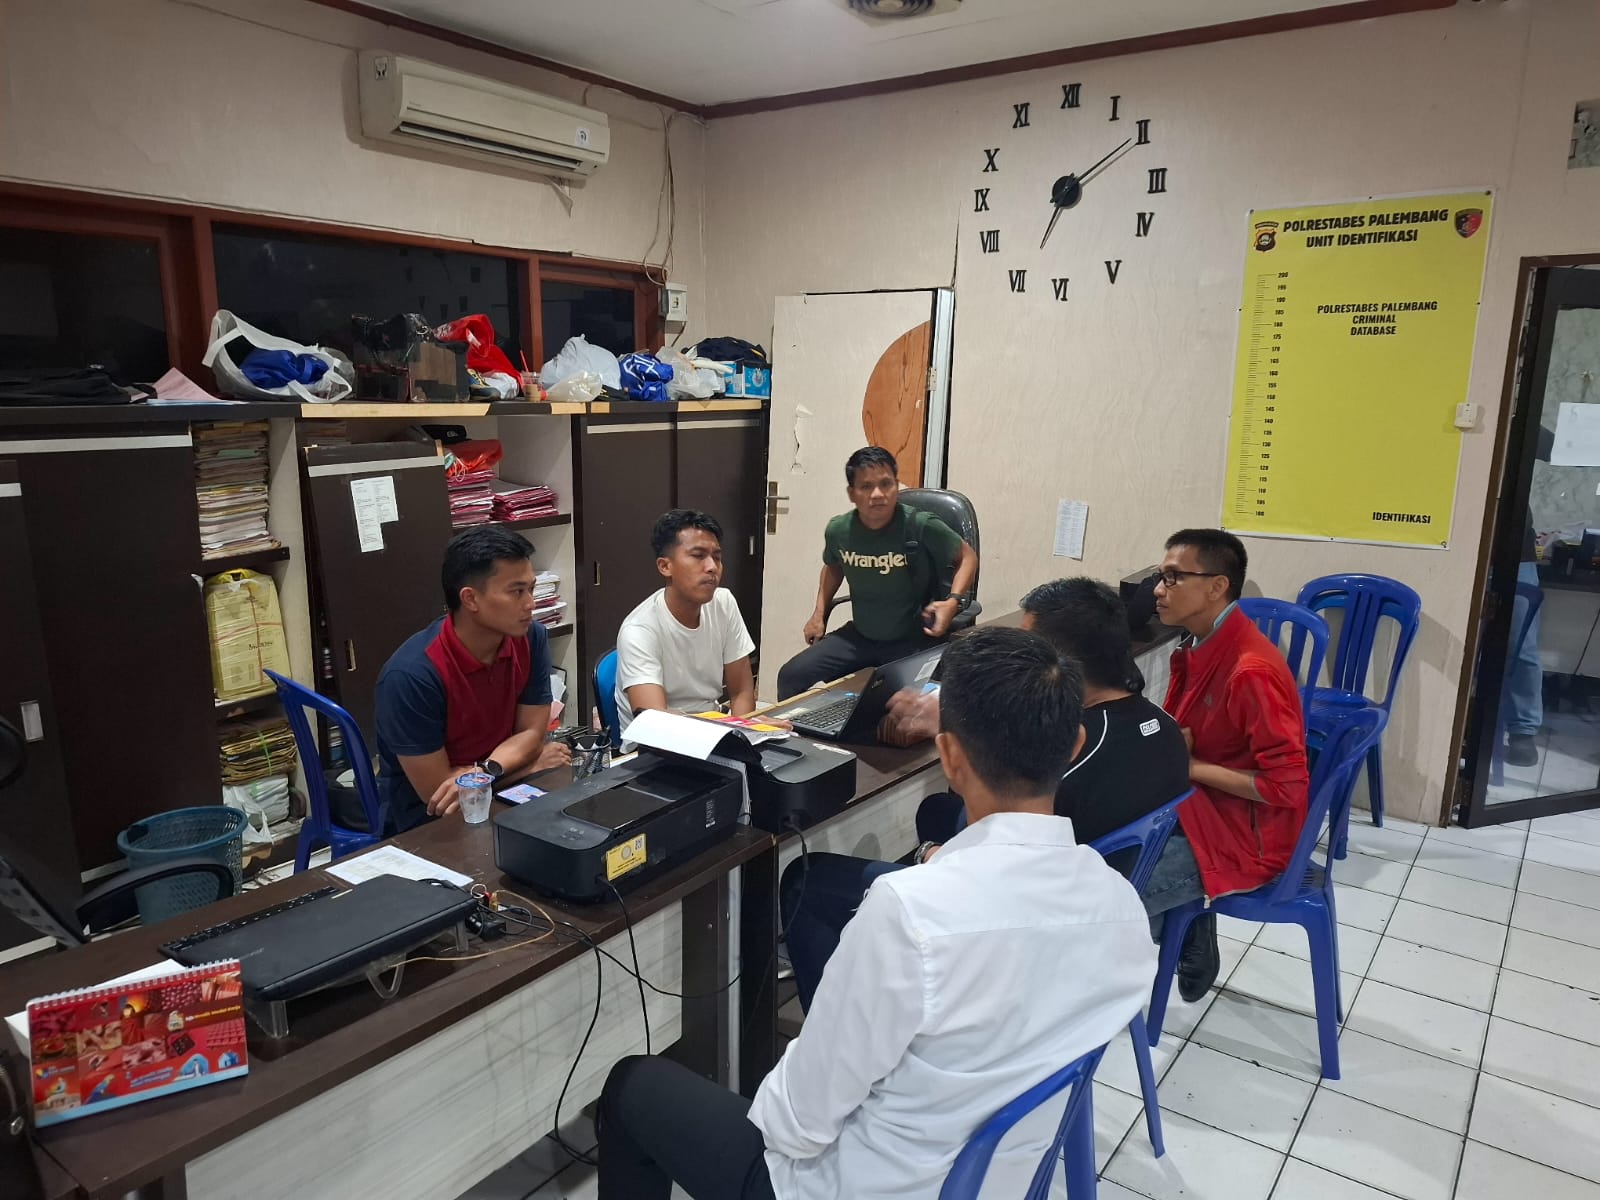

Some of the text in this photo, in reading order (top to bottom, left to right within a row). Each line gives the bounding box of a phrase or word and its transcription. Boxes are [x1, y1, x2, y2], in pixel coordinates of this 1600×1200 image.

[1060, 83, 1082, 109] XII
[1108, 95, 1121, 121] I
[1012, 102, 1030, 128] XI
[1135, 119, 1151, 145] II
[982, 148, 1000, 172] X
[1147, 168, 1168, 194] III
[974, 188, 990, 212] IX
[1135, 212, 1155, 237] IV
[1283, 215, 1365, 232] POLRESTABES
[1368, 209, 1449, 226] PALEMBANG
[979, 229, 1000, 254] VIII
[1306, 229, 1418, 248] UNIT IDENTIFIKASI
[1008, 269, 1027, 293] VII
[1104, 260, 1122, 285] V
[1051, 278, 1069, 301] VI
[1317, 301, 1438, 314] POLRESTABES PALEMBANG
[1352, 314, 1397, 324] CRIMINAL
[1350, 325, 1397, 336] DATABASE
[1372, 511, 1431, 524] IDENTIFIKASI
